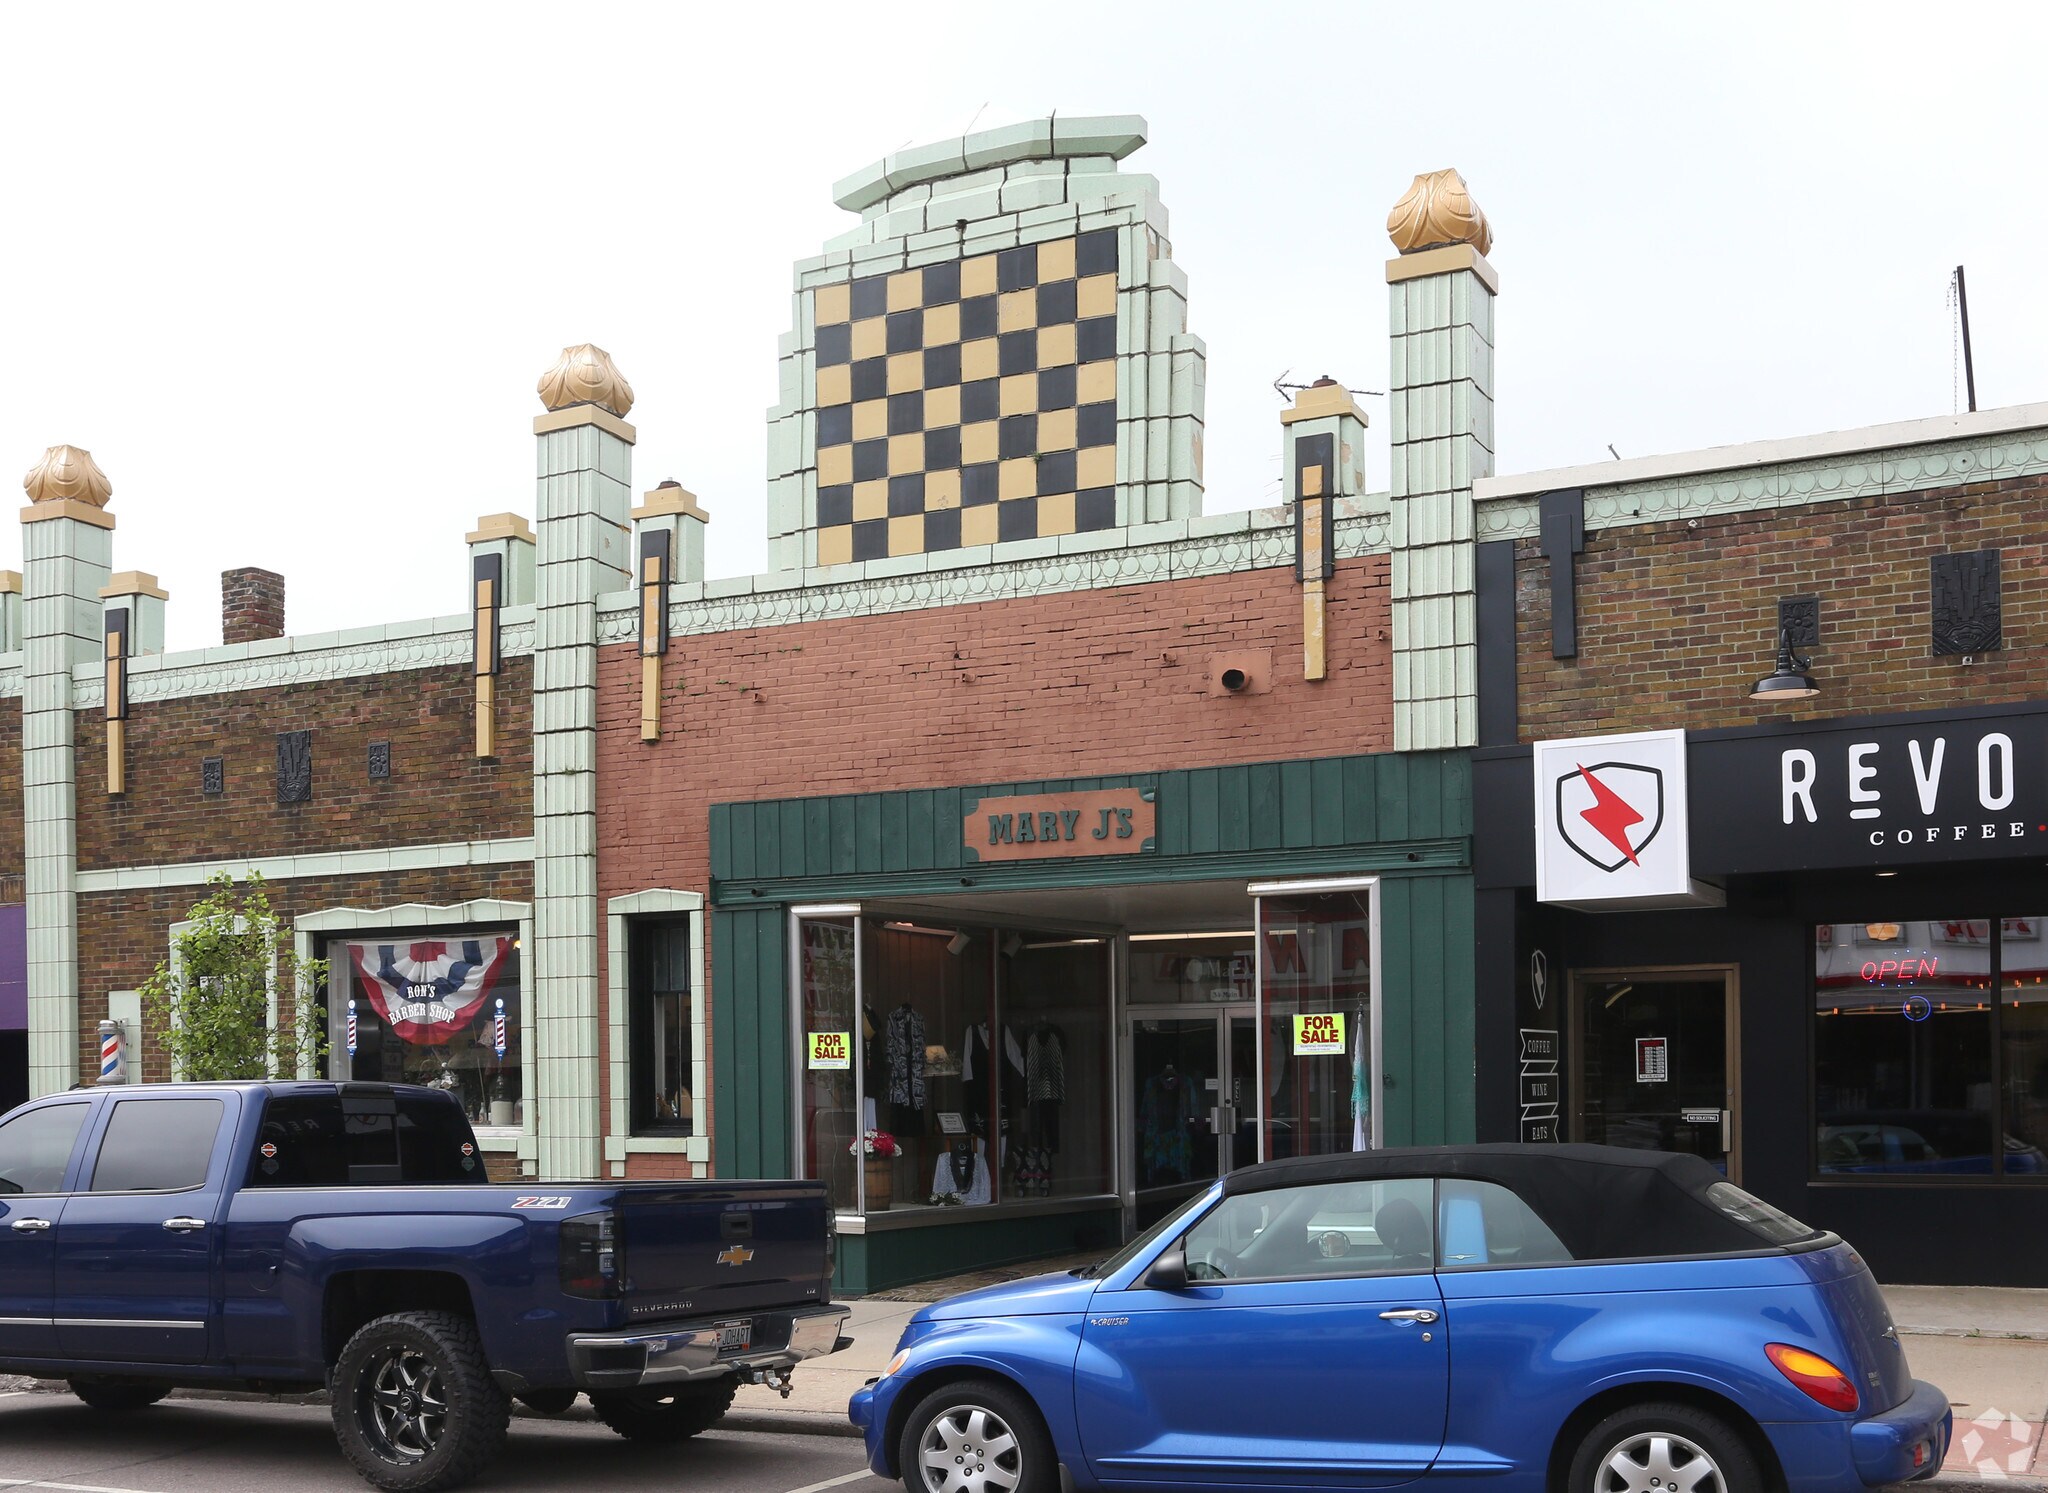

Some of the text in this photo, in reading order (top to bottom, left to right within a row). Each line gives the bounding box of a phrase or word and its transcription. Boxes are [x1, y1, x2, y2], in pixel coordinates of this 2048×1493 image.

[1781, 732, 2014, 825] REVO
[988, 807, 1133, 846] MARY J'S
[1869, 822, 2025, 846] COFFEE
[1860, 958, 1938, 981] OPEN
[406, 983, 437, 999] RON'S
[388, 1002, 456, 1026] BARBER SHOP
[1303, 1015, 1334, 1030] FOR
[816, 1034, 841, 1047] FOR
[1300, 1029, 1340, 1044] SALE
[814, 1046, 846, 1059] SALE
[1527, 1039, 1551, 1053] COFFEE
[1531, 1083, 1548, 1097] WINE
[1532, 1126, 1548, 1140] EATS
[511, 1196, 572, 1209] Z71
[633, 1300, 692, 1313] SILVERADO
[1097, 1317, 1130, 1326] CRUISER
